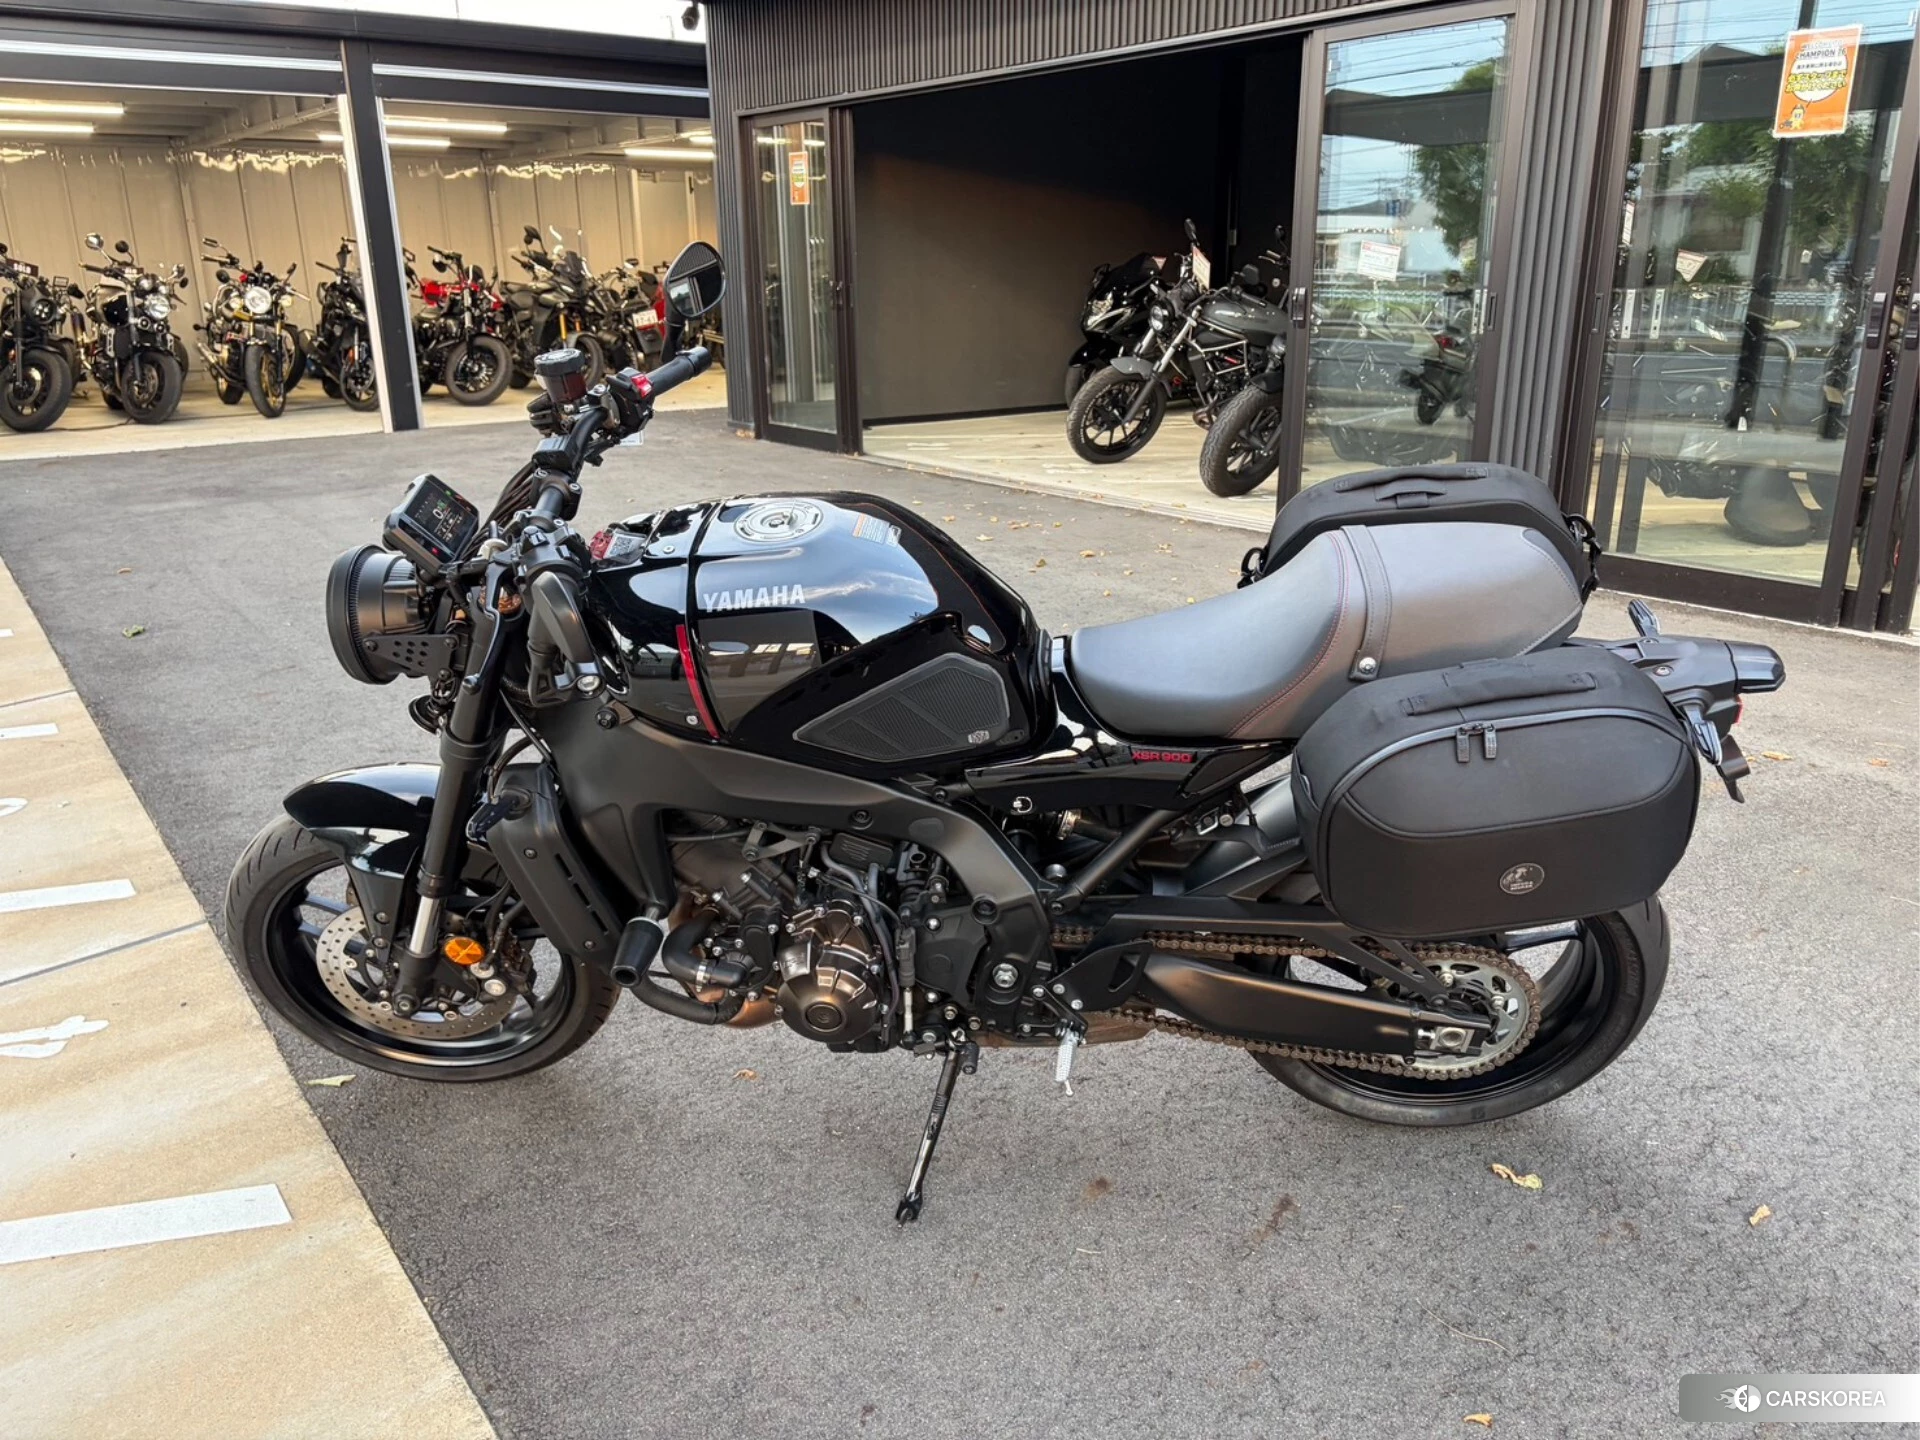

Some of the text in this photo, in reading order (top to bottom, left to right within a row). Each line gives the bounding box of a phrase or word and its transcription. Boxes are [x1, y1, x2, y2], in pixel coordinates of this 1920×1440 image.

[703, 584, 806, 613] YAMAHA
[1132, 750, 1192, 763] XSR 900
